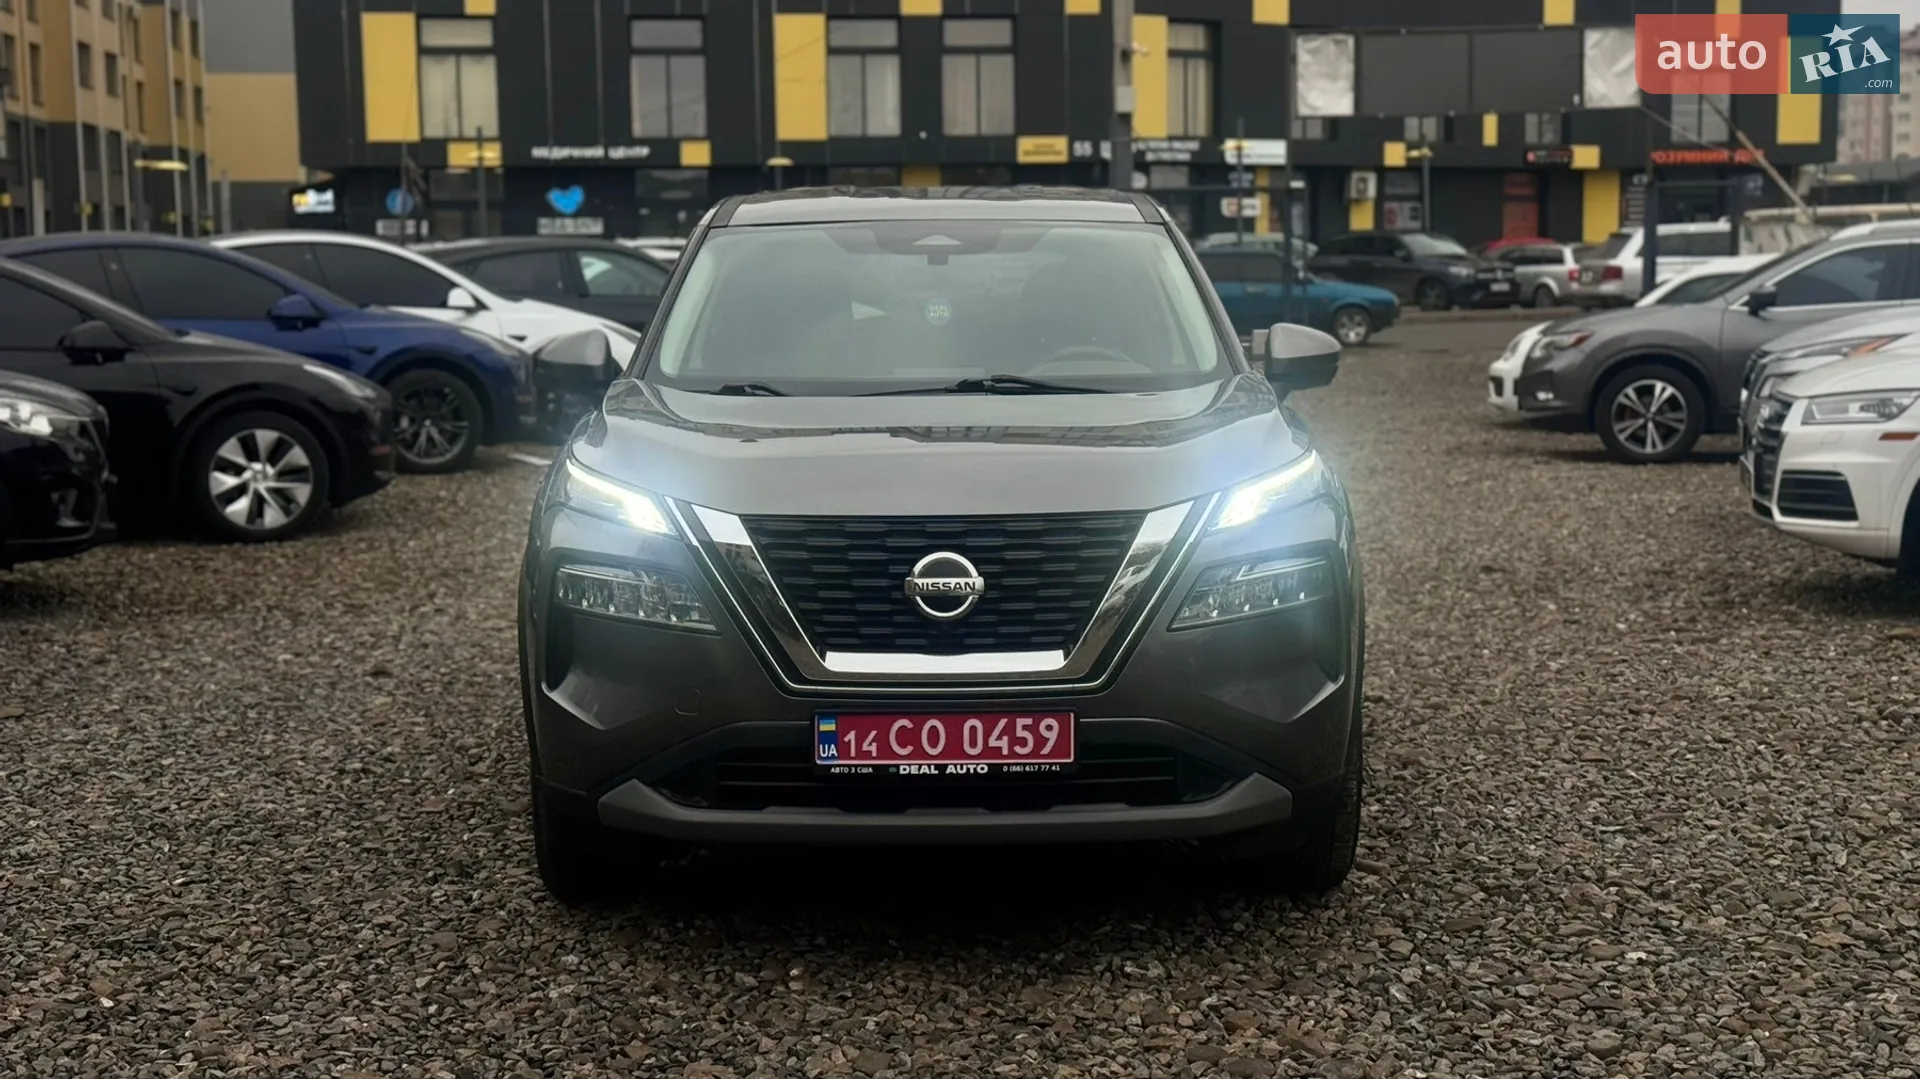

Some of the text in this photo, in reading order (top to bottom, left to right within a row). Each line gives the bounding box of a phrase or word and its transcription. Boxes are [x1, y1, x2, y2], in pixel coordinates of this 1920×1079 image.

[913, 582, 976, 592] NISSAN
[820, 717, 1060, 757] UA 14 CO 0459
[900, 765, 939, 774] DEAL
[945, 764, 989, 774] AUTO
